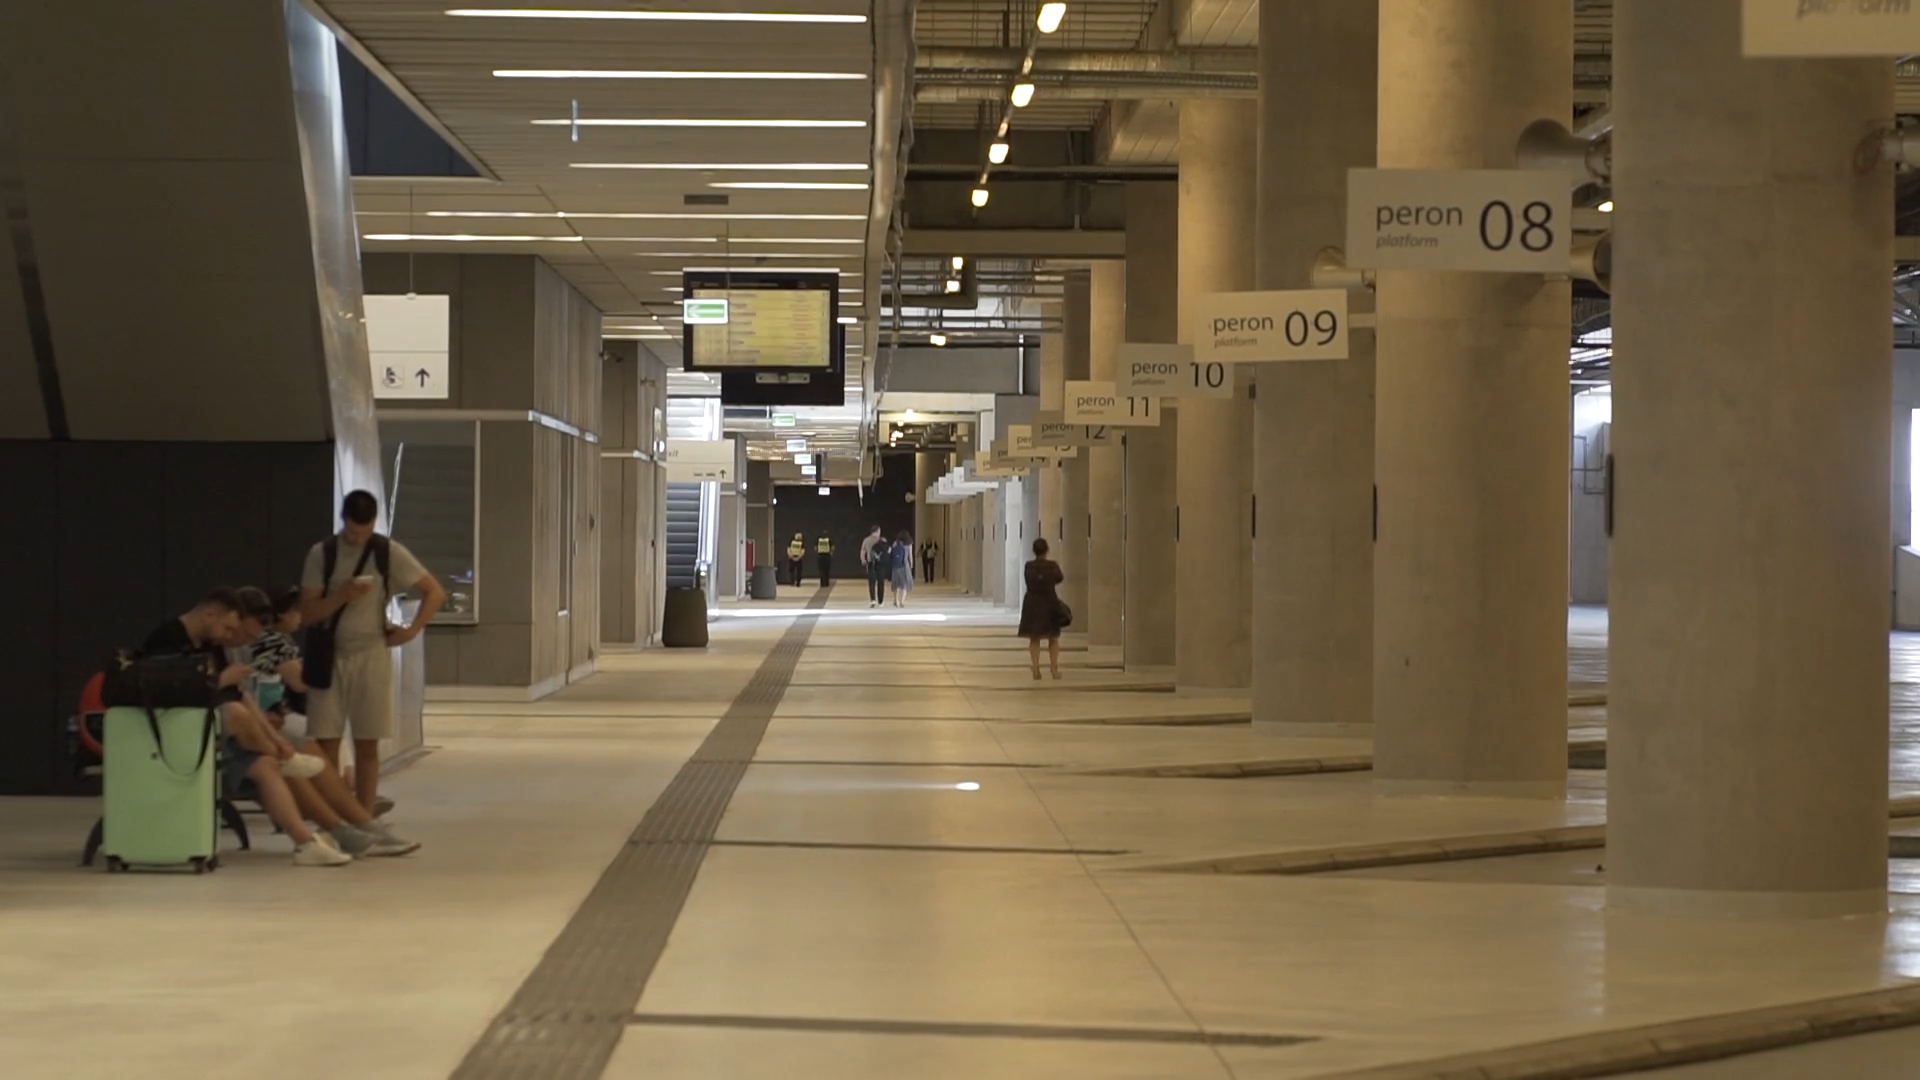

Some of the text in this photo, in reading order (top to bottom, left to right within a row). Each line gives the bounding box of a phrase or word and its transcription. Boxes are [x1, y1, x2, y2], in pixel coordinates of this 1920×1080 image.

[1376, 199, 1554, 252] peron 08
[1376, 232, 1439, 249] platform
[1213, 309, 1338, 347] peron 09
[1213, 336, 1258, 349] platform
[1131, 362, 1224, 388] peron 10
[1076, 396, 1149, 417] peron 11
